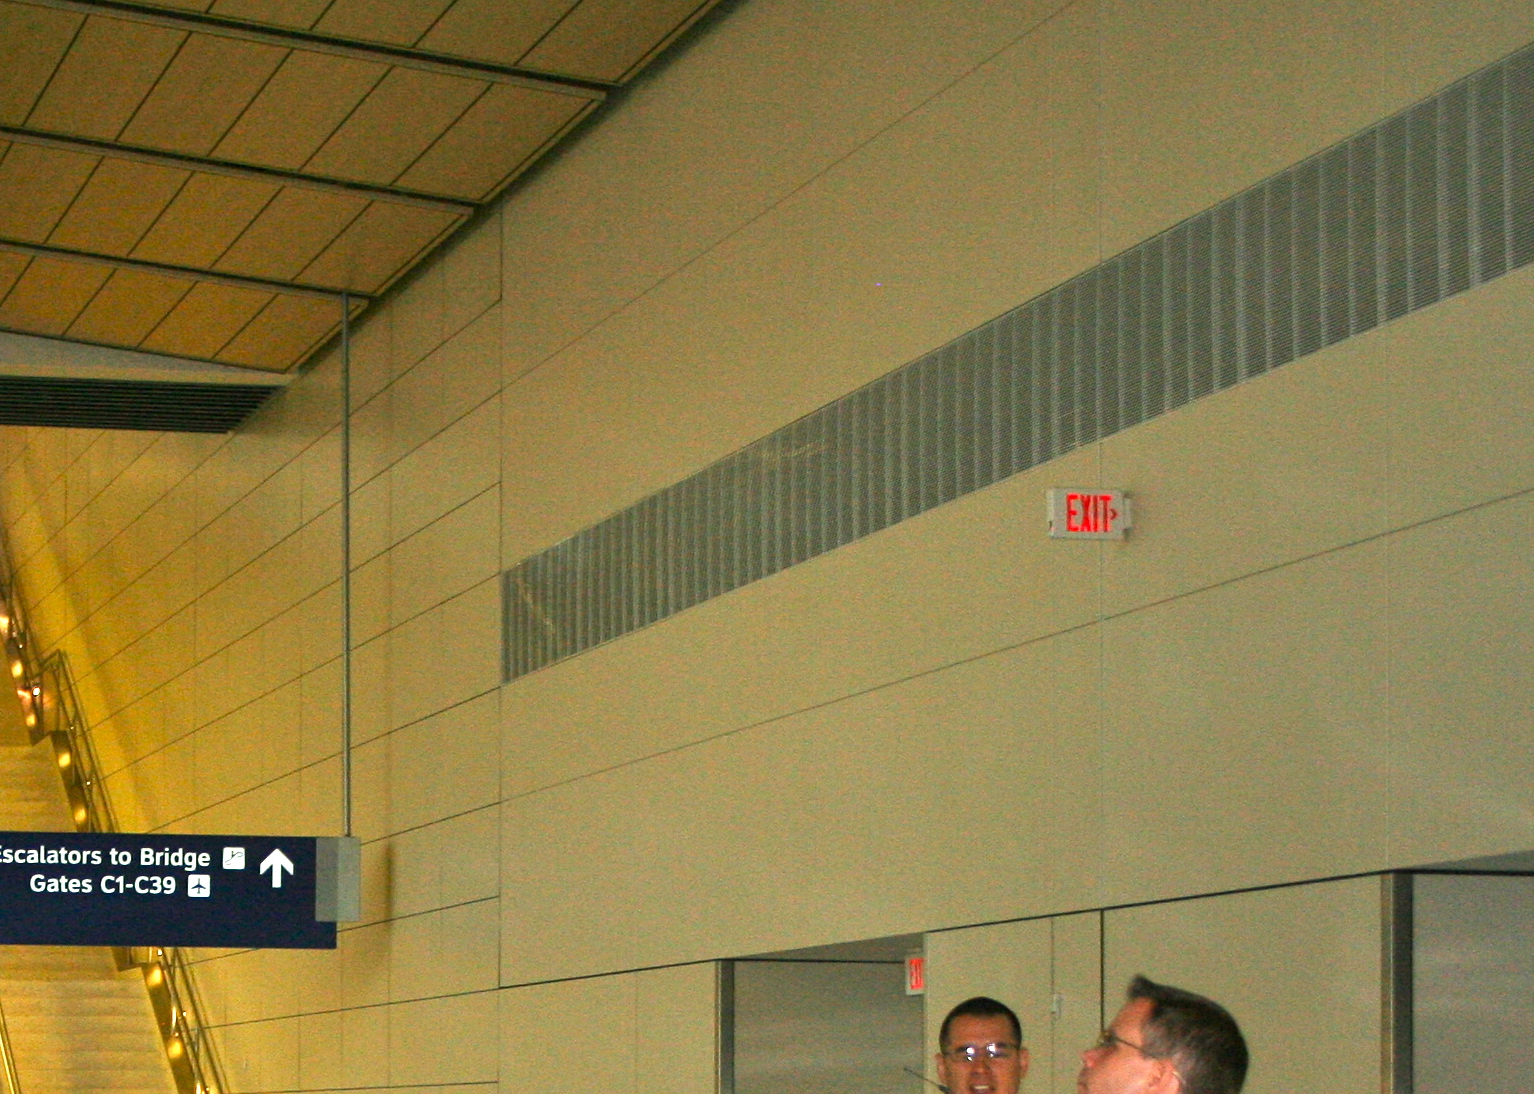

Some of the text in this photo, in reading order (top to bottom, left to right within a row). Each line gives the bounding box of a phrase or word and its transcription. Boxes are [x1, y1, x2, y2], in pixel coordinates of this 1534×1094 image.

[1066, 492, 1113, 533] EXIT
[109, 847, 133, 866] to
[140, 847, 212, 872] Bridge
[29, 873, 177, 894] Gates C1-C39
